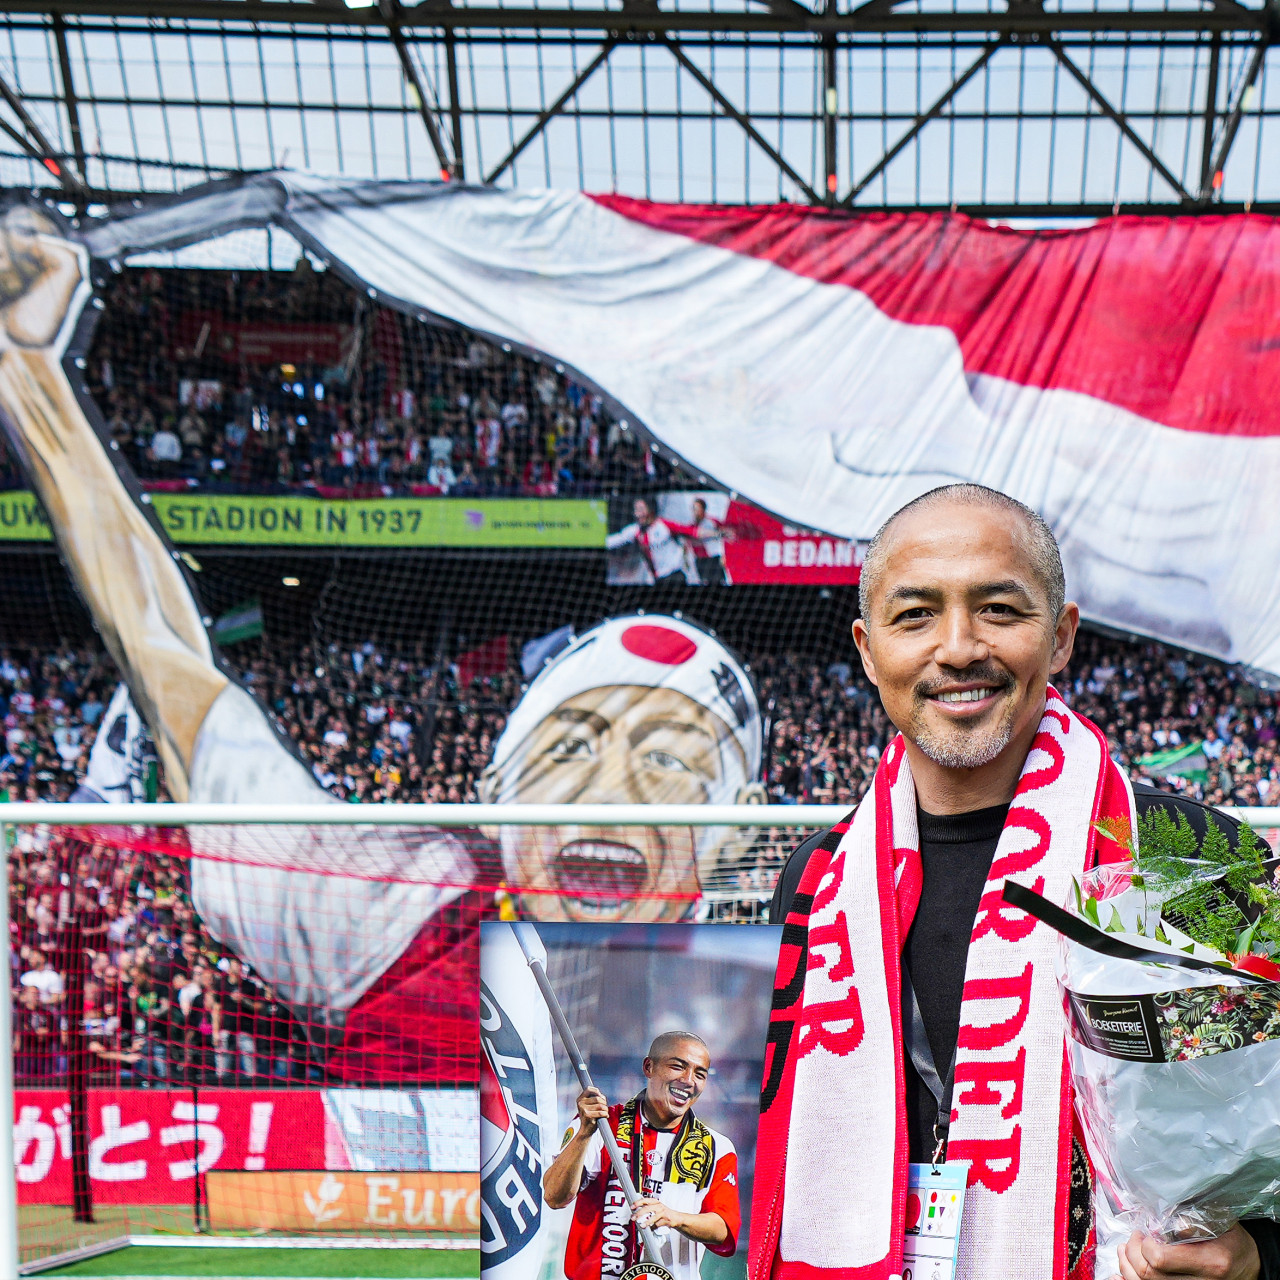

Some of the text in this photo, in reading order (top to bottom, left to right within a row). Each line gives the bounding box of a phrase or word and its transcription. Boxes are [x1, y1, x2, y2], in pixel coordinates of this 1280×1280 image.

[167, 505, 302, 532] STADION
[316, 508, 347, 532] IN
[358, 509, 423, 533] 1937
[1091, 1018, 1142, 1033] BOEKETTERIE
